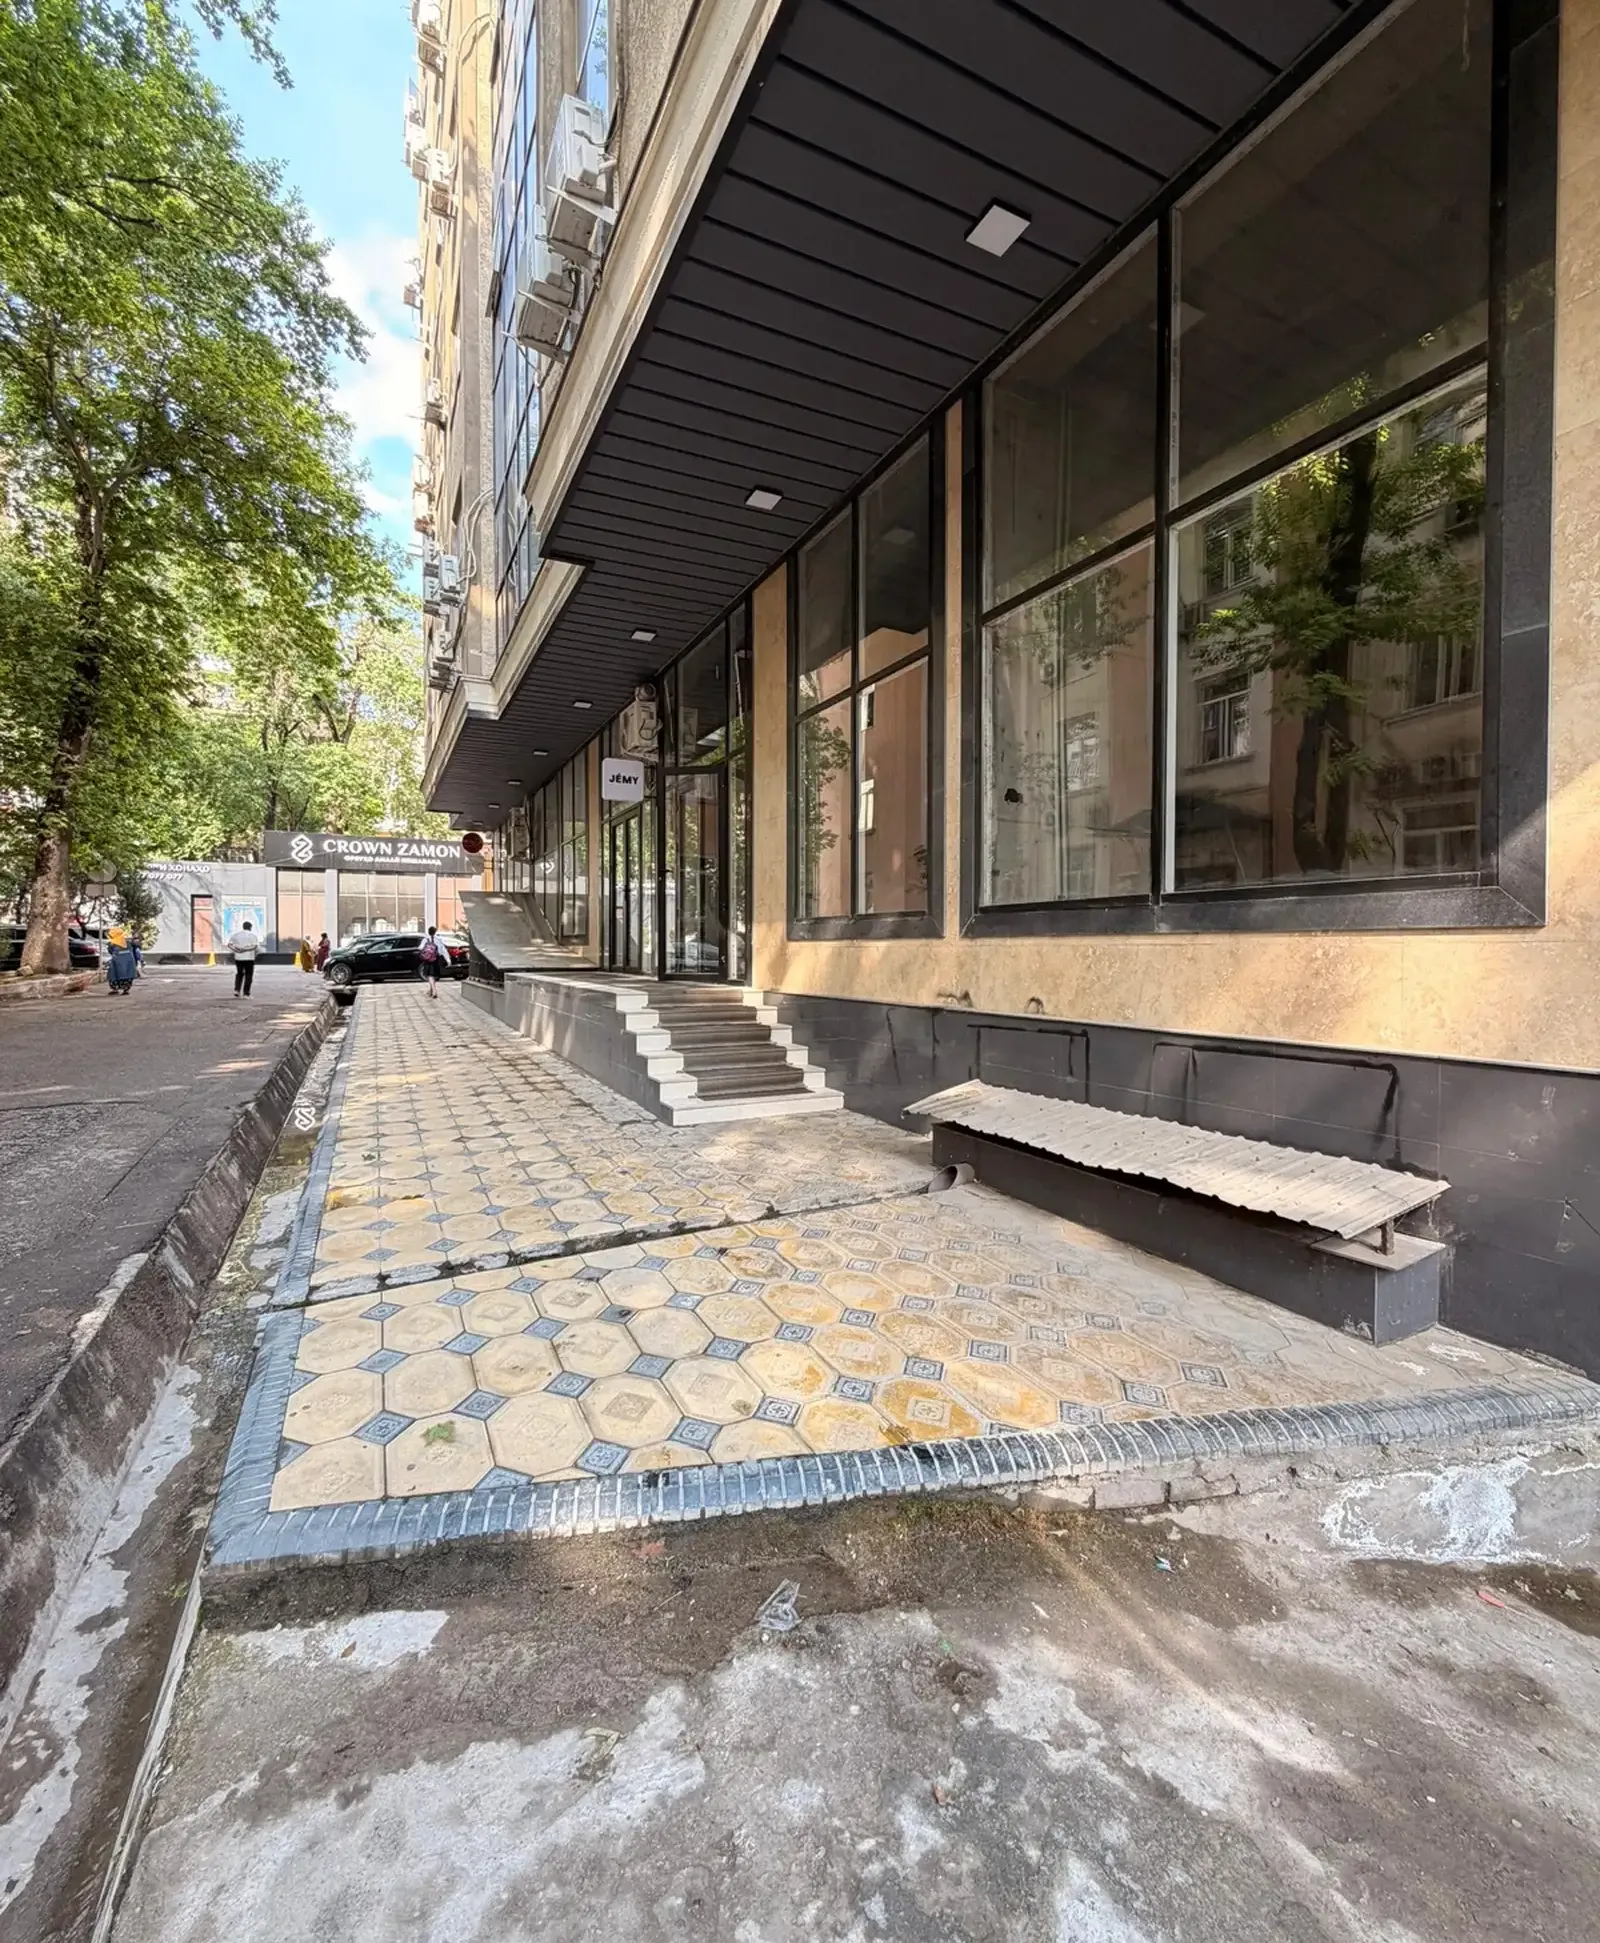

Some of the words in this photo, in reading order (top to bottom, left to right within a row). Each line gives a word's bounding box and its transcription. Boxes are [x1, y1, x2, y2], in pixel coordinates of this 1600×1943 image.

[608, 773, 639, 785] JÉMY
[323, 839, 392, 856] CROWN
[397, 843, 461, 859] ZAMON
